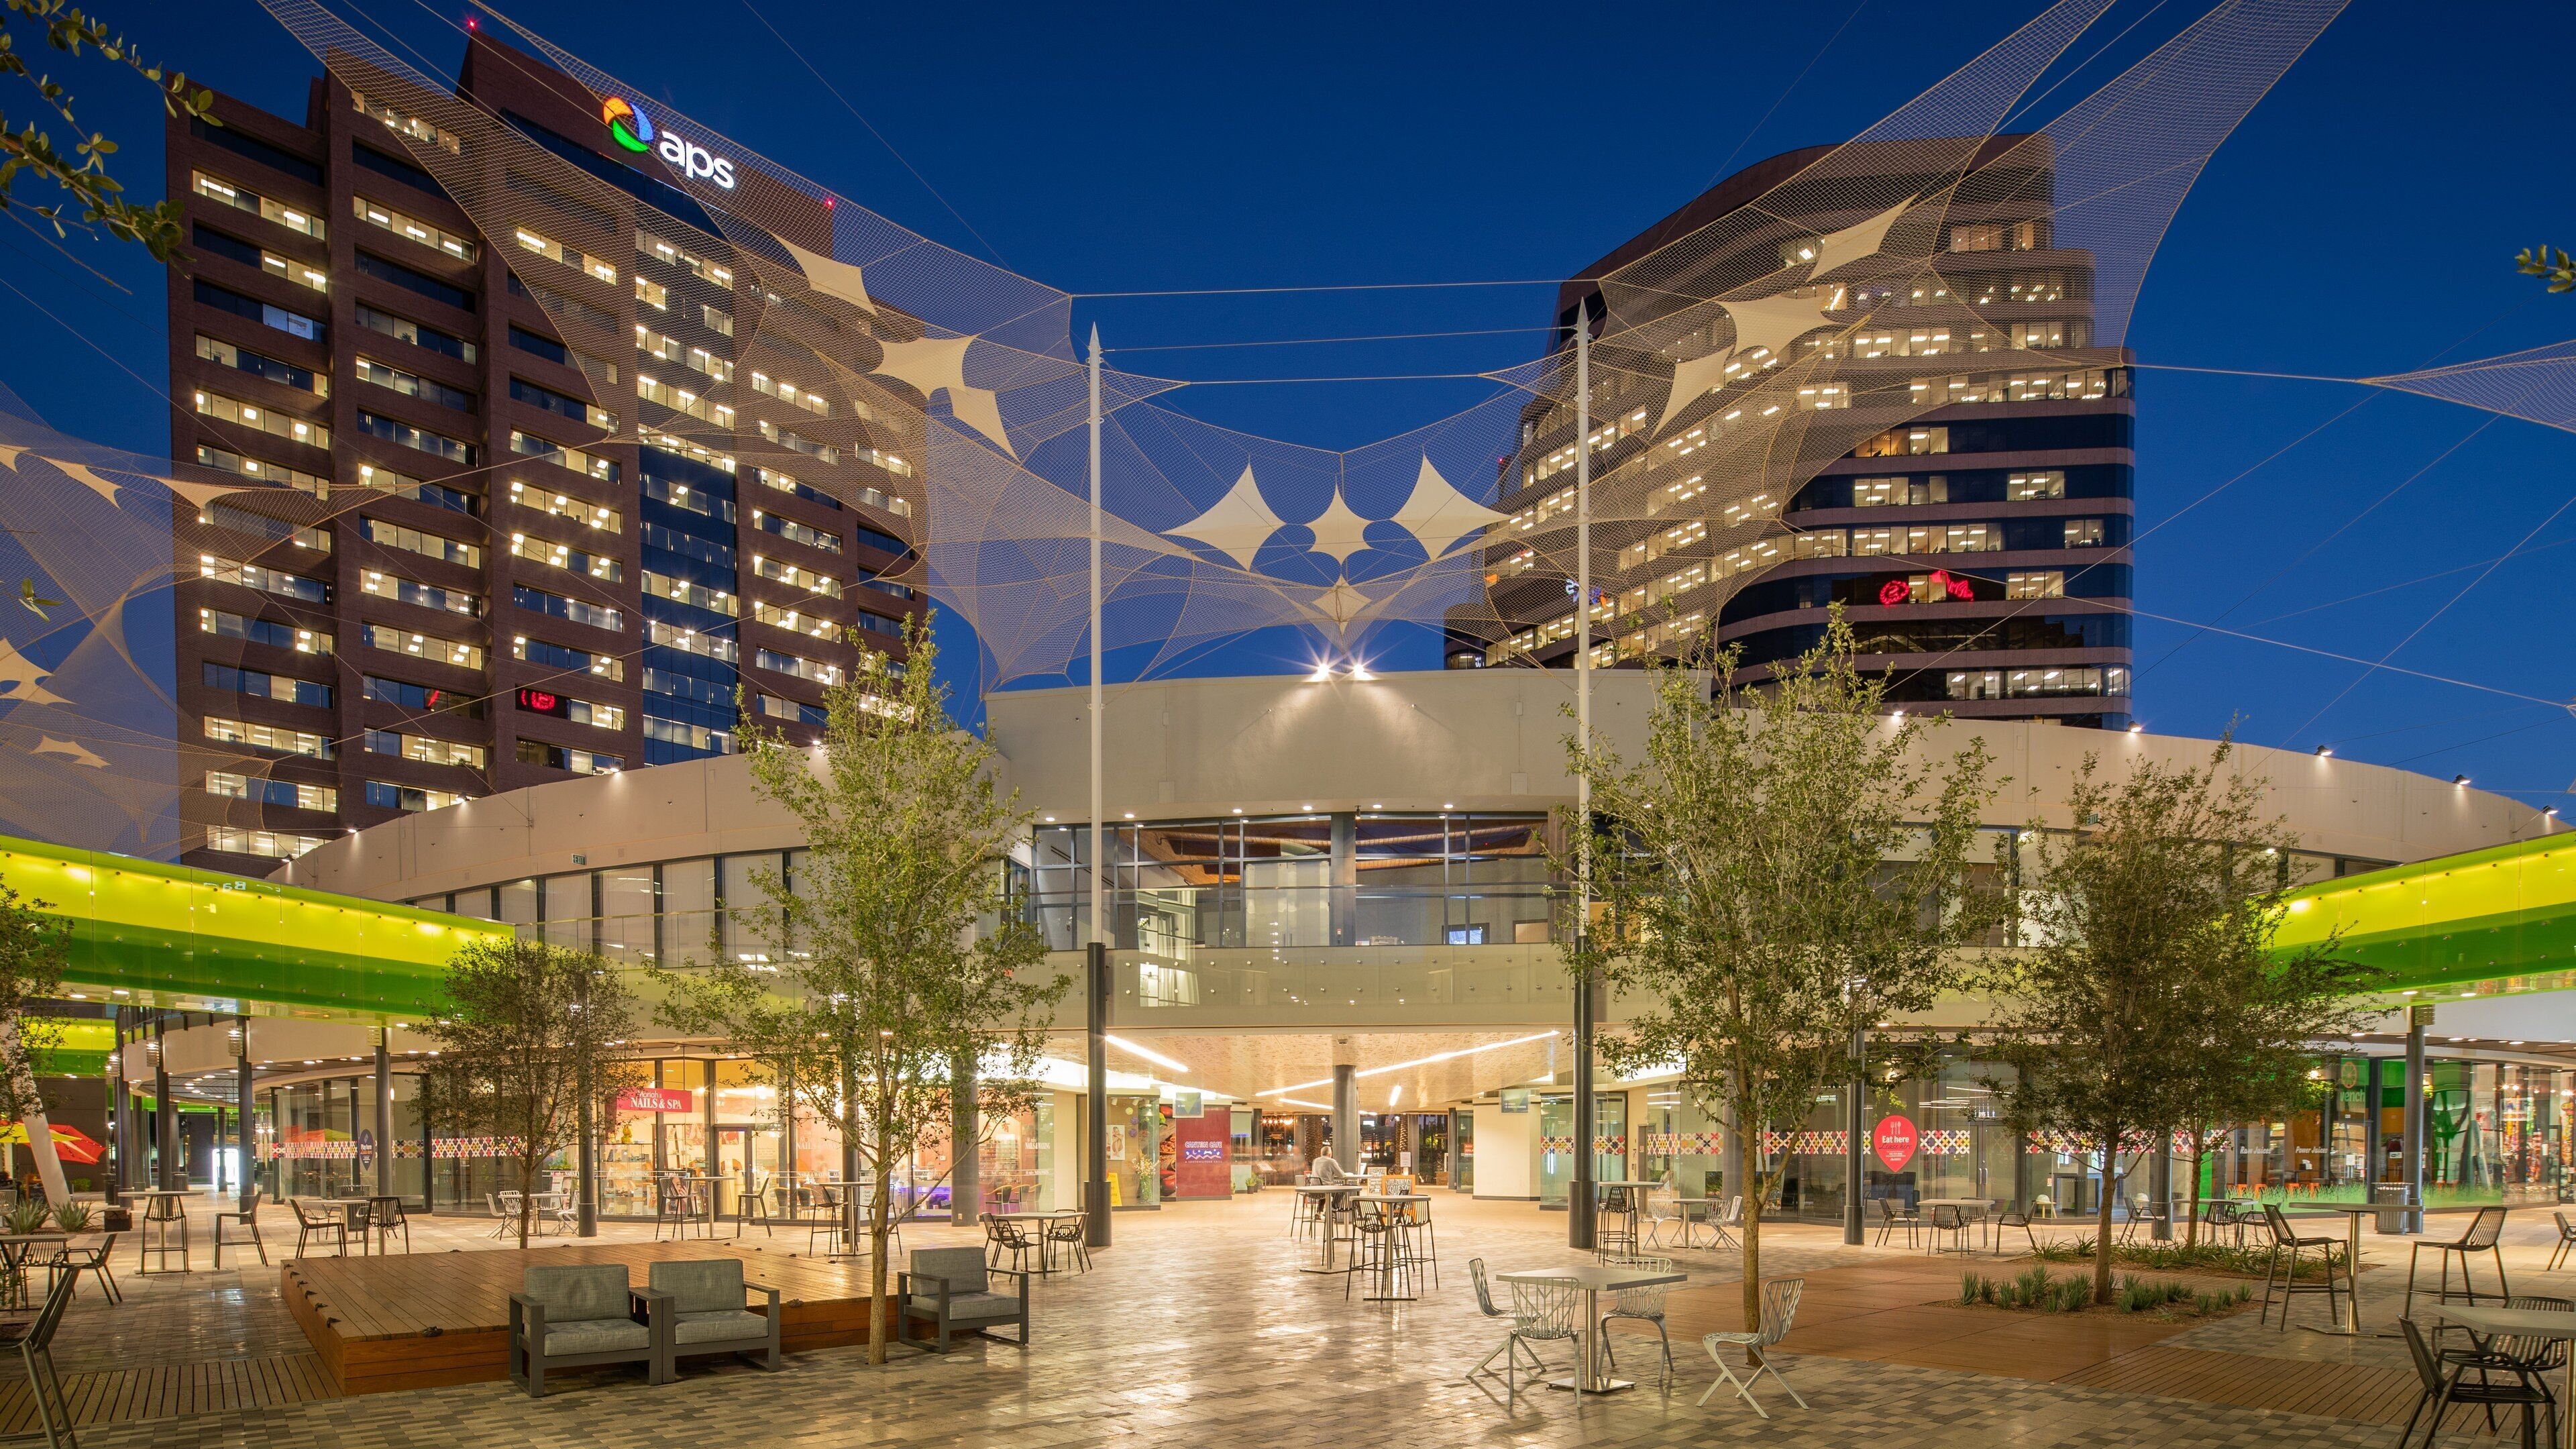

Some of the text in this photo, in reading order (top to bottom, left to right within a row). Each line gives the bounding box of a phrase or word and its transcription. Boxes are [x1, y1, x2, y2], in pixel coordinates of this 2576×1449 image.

[660, 131, 735, 189] aps
[631, 1097, 682, 1110] NAILS & SPA
[1882, 1135, 1910, 1144] Eat here
[2240, 1146, 2272, 1155] Raw Juices
